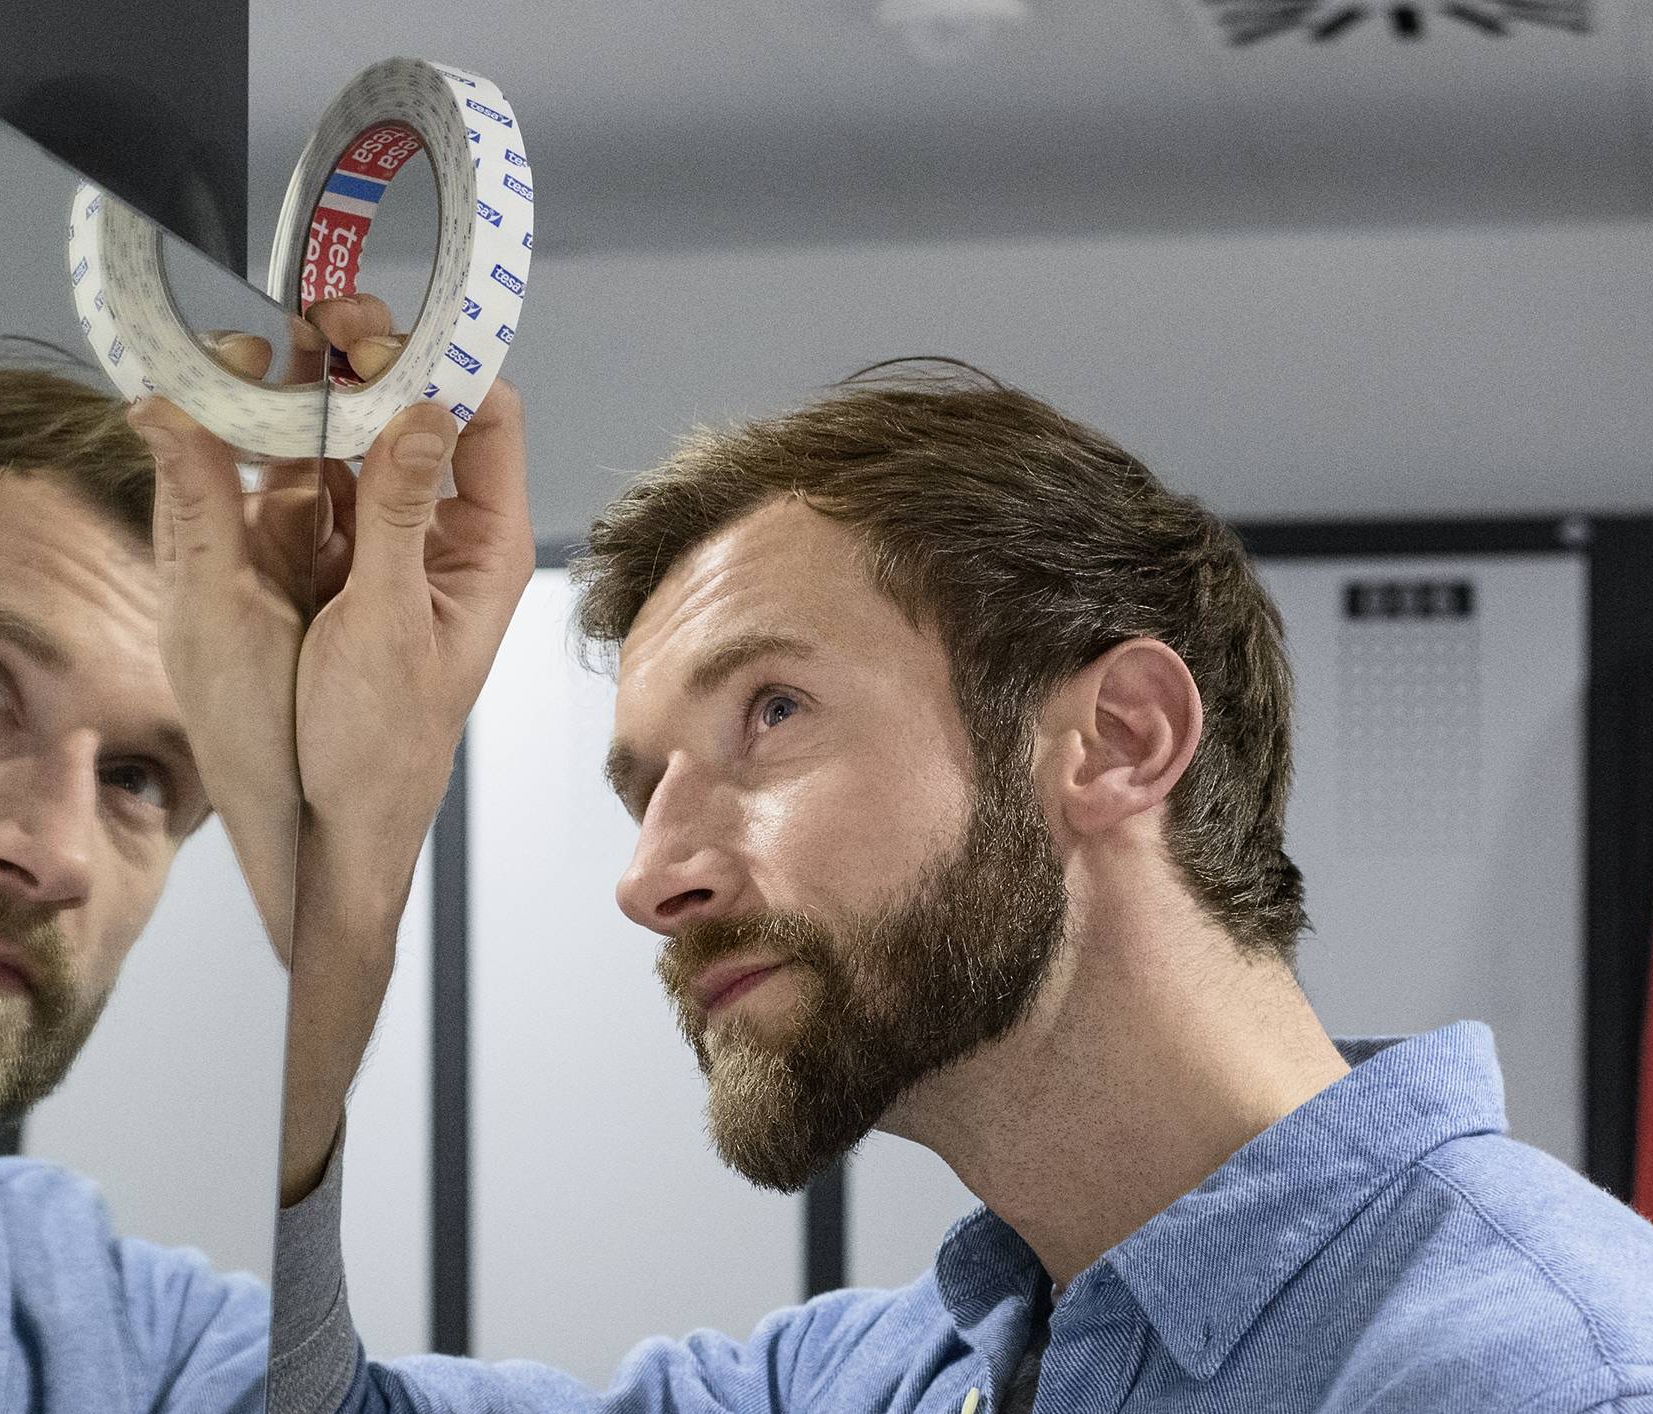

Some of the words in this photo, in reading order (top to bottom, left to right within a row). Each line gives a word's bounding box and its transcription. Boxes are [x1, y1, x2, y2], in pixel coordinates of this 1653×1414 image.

[468, 101, 500, 121] tesa
[378, 136, 418, 170] esa
[507, 177, 533, 200] tesa
[495, 267, 521, 293] tesa
[446, 345, 469, 366] tesa
[454, 405, 474, 421] tes
